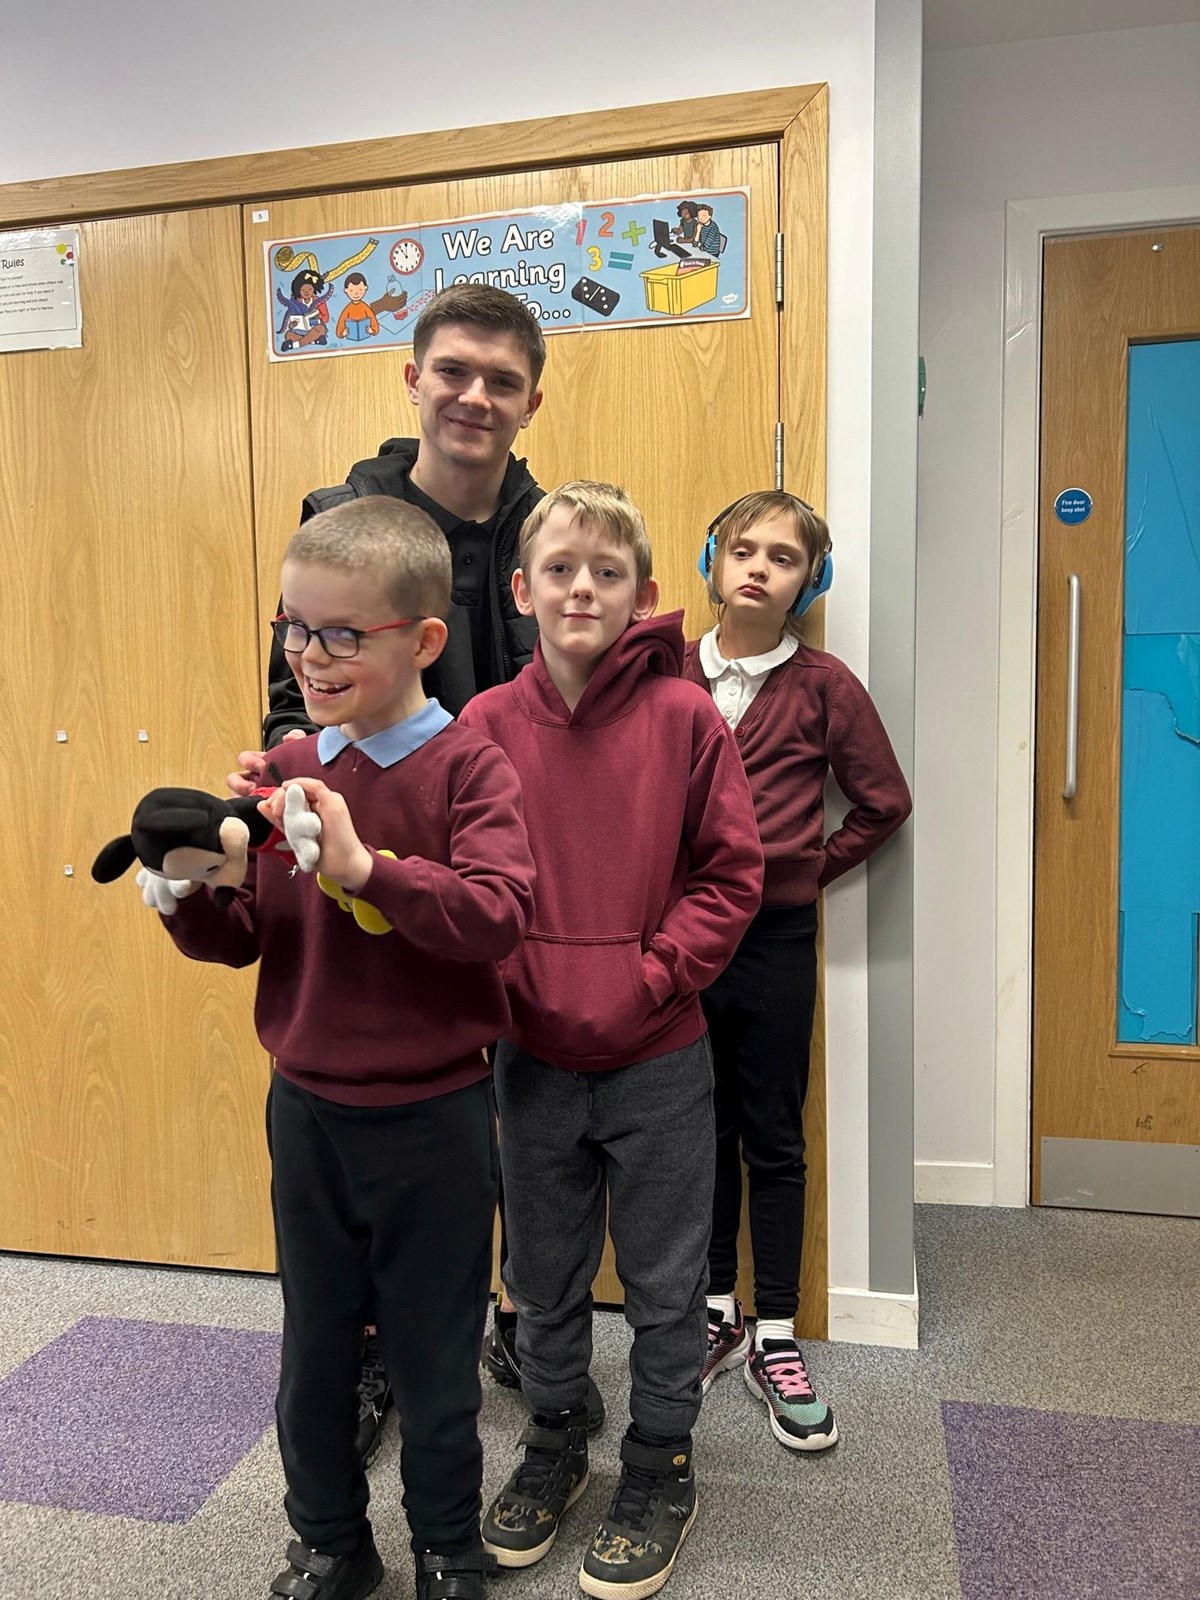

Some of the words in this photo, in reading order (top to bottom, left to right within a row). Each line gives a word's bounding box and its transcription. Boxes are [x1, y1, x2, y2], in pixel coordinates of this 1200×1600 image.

[442, 228, 492, 260] We
[501, 224, 554, 253] Are
[576, 218, 587, 246] 1
[598, 211, 615, 238] 2
[1, 258, 24, 269] Rules
[586, 245, 603, 272] 3
